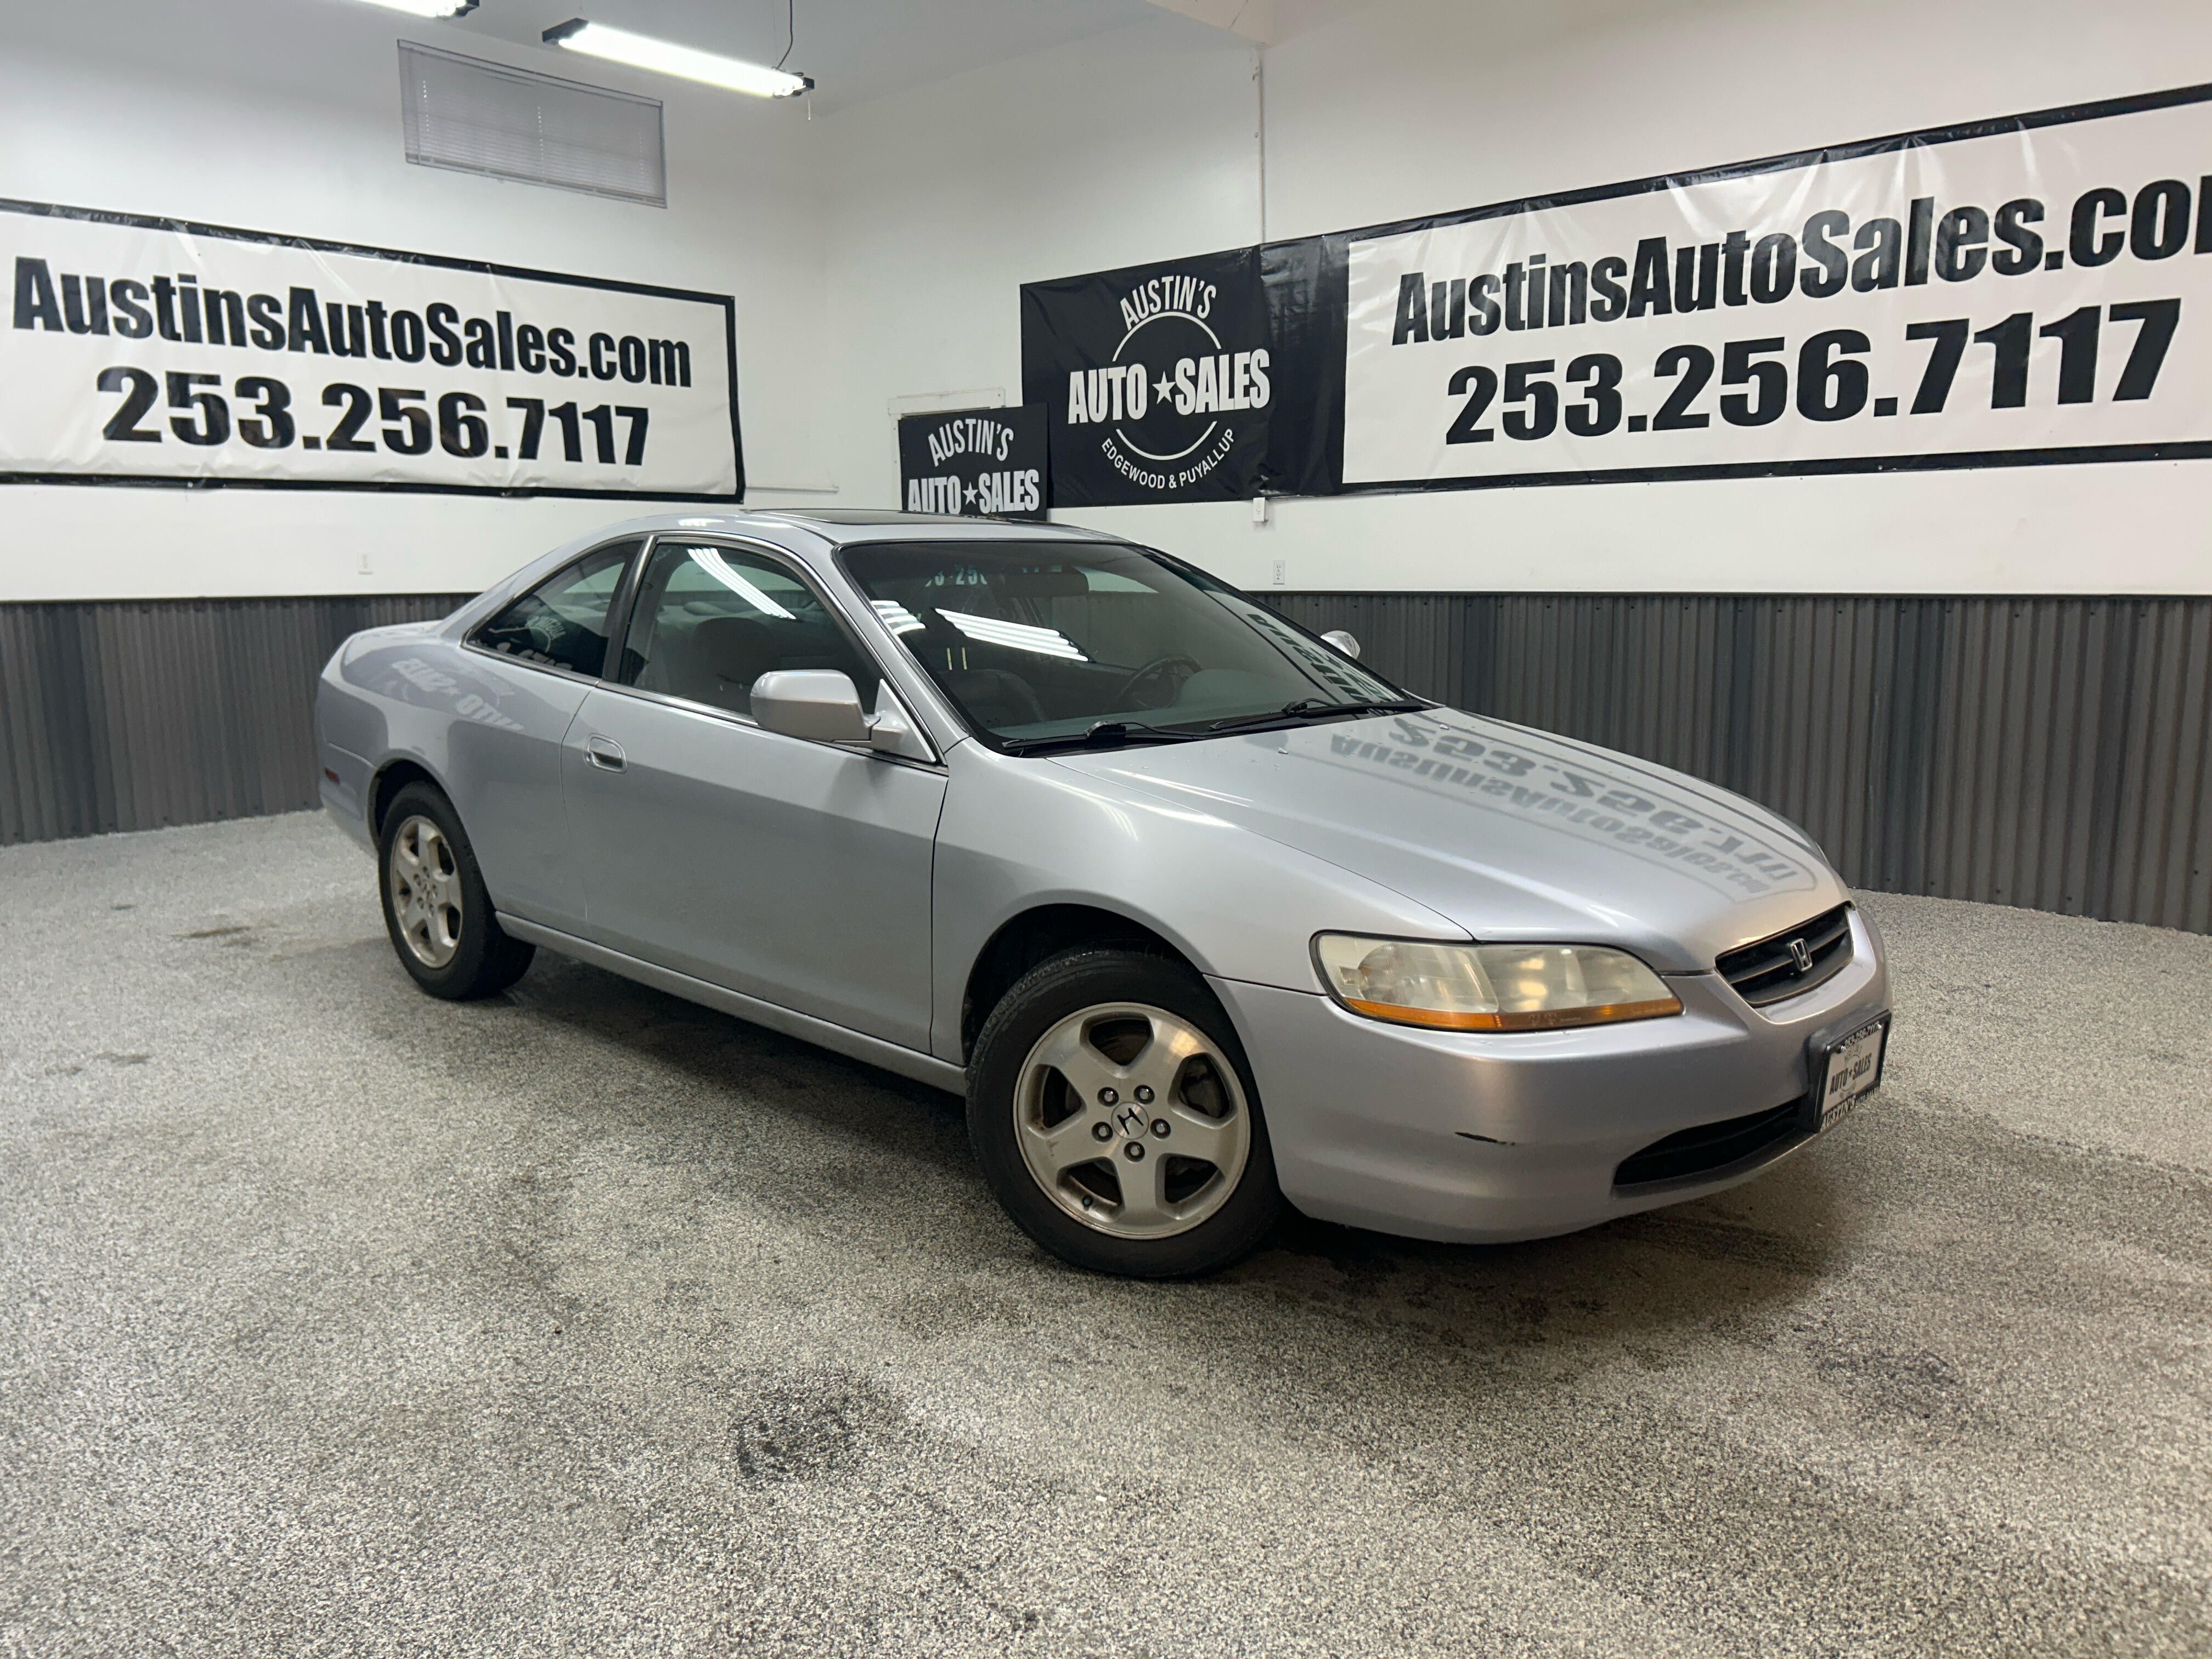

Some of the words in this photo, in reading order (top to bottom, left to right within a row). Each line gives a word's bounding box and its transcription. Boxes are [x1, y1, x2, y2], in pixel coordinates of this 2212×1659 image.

[13, 257, 691, 387] AustinsAutoSales.com
[1120, 275, 1216, 330] AUSTIN'S
[1068, 363, 1147, 424] AUTO
[1175, 349, 1270, 415] SALES
[1446, 298, 2181, 445] 253.256.7117
[97, 366, 649, 466] 253.256.7117
[928, 419, 1014, 467] AUSTIN'S
[1102, 438, 1165, 489] EDGEWOOD
[1169, 475, 1177, 488] &
[1179, 428, 1234, 487] PUYALLUP
[908, 475, 962, 514] AUTO
[978, 469, 1040, 514] SALES
[1829, 1068, 1848, 1095] AUTO
[1853, 1052, 1872, 1080] SALES
